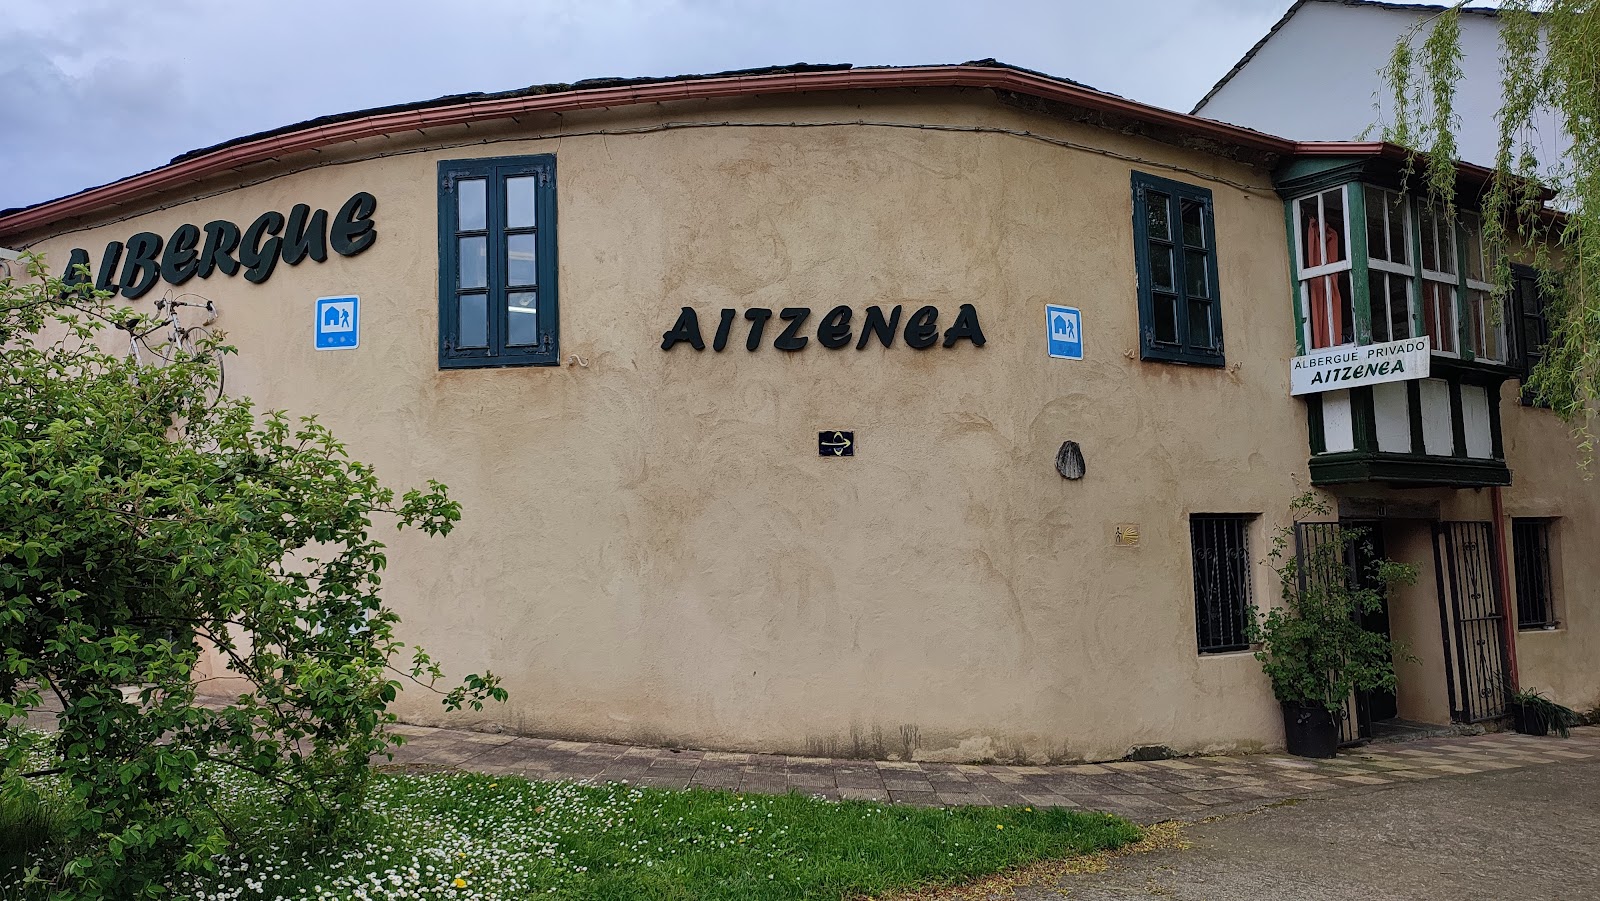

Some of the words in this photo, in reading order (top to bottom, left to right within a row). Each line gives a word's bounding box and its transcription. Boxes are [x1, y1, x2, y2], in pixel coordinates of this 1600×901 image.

[60, 191, 377, 300] ALBERGUE
[661, 304, 986, 351] AITZENEA
[1294, 352, 1358, 370] ALBERGUE
[1367, 341, 1425, 359] PRIVADO
[1310, 359, 1405, 385] AITZENEA
